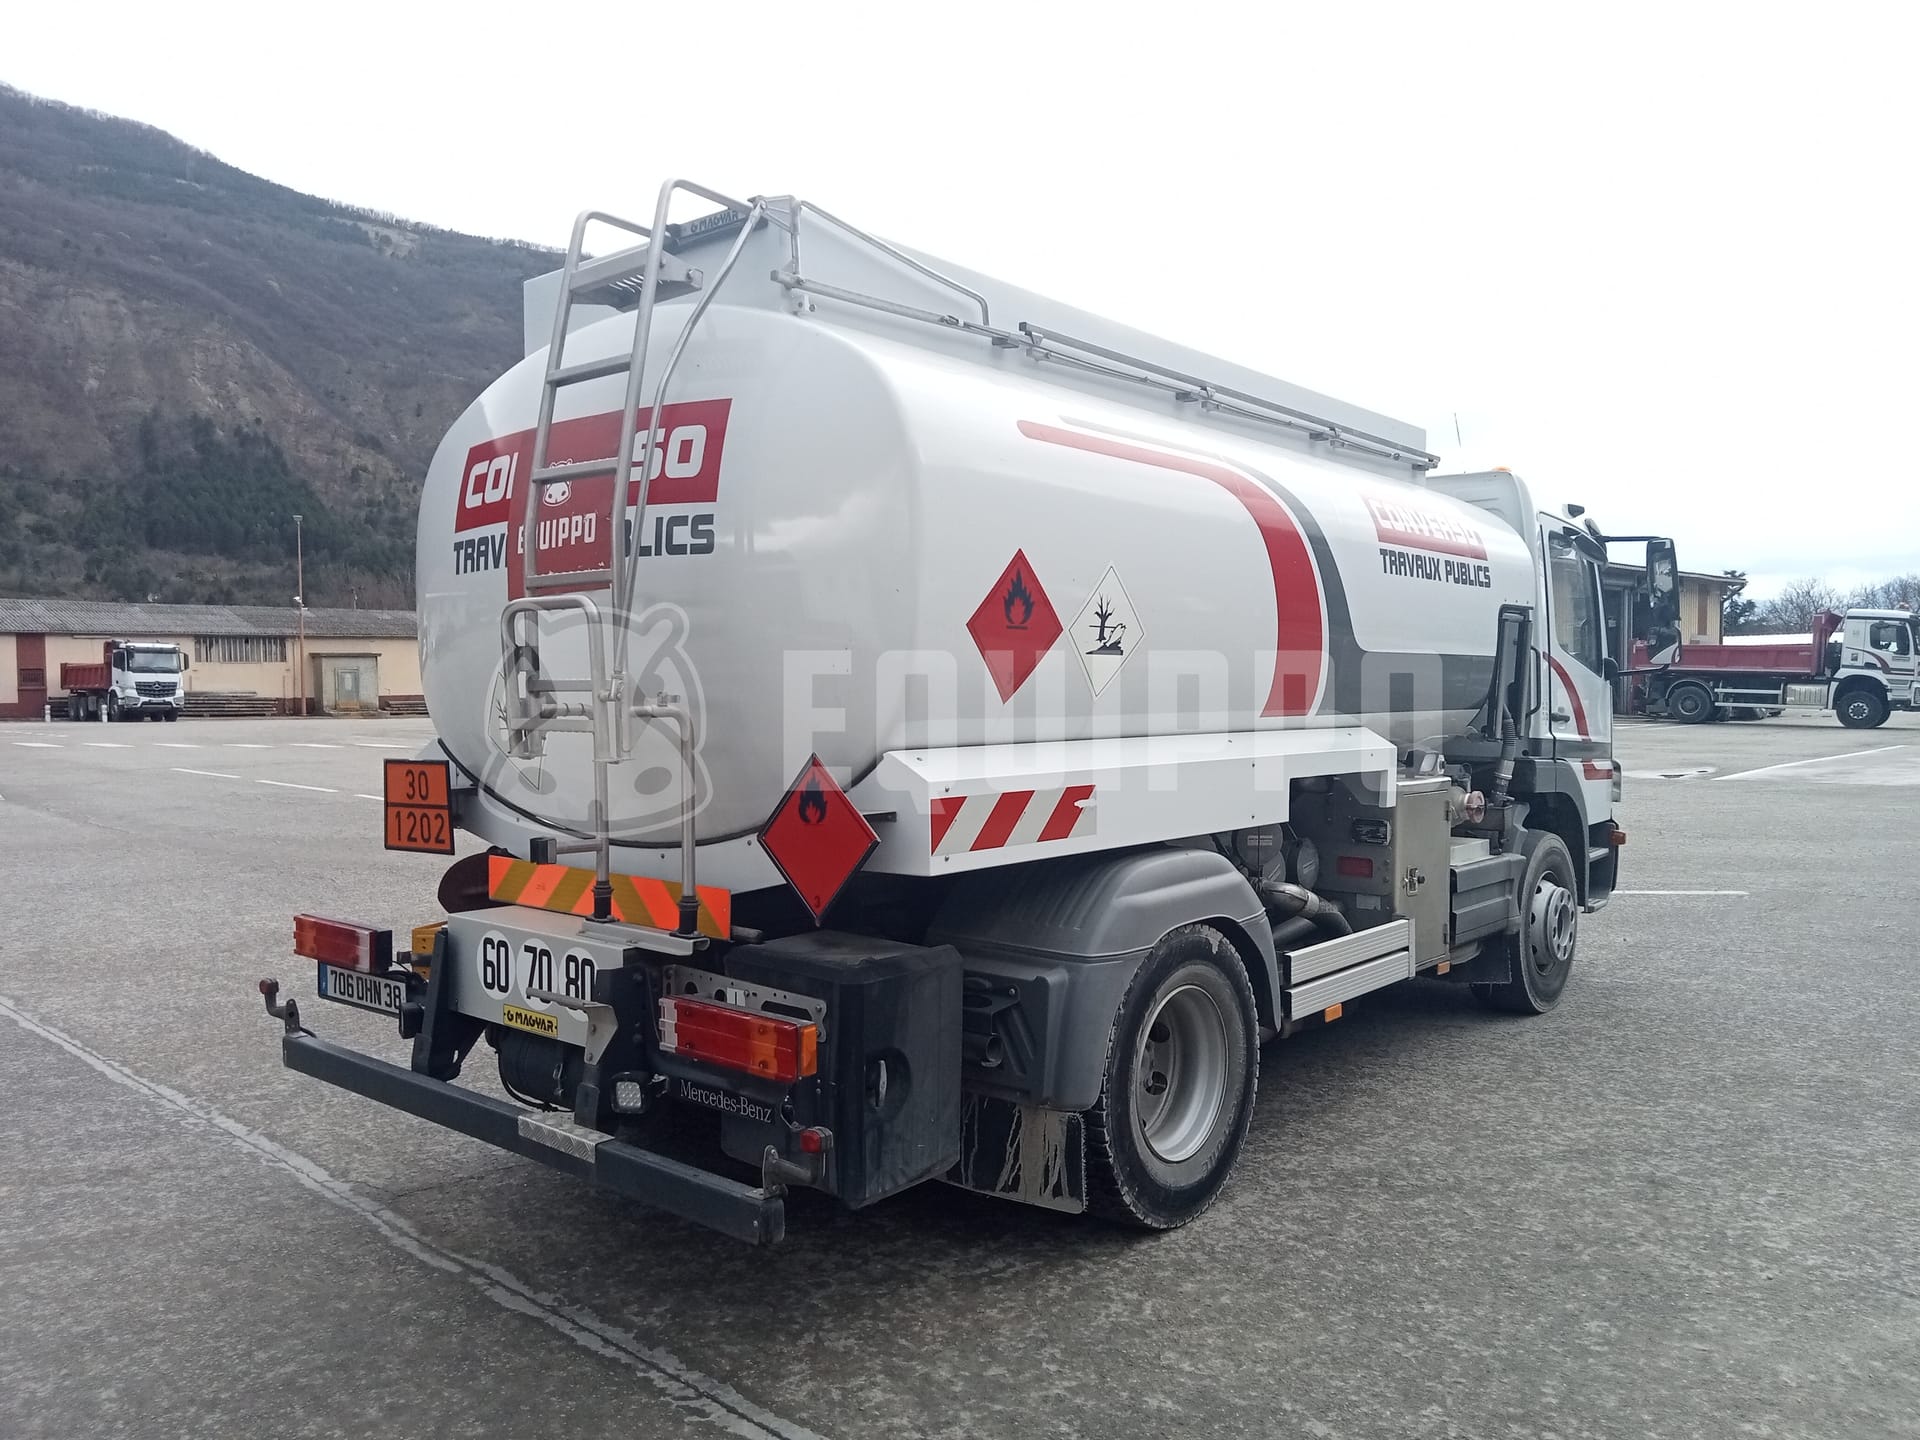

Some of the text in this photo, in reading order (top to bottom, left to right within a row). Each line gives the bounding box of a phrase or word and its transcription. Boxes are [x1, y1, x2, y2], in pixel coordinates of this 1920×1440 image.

[1379, 548, 1491, 588] TRAVAUX PUBLICS
[405, 769, 429, 801] 30
[395, 810, 446, 845] 1202
[482, 937, 510, 994] 60
[523, 944, 552, 1004] 70
[330, 969, 402, 1010] 706 DHN 38
[515, 1011, 554, 1033] MAGYAR
[680, 1079, 771, 1123] Mercedes-Benz
